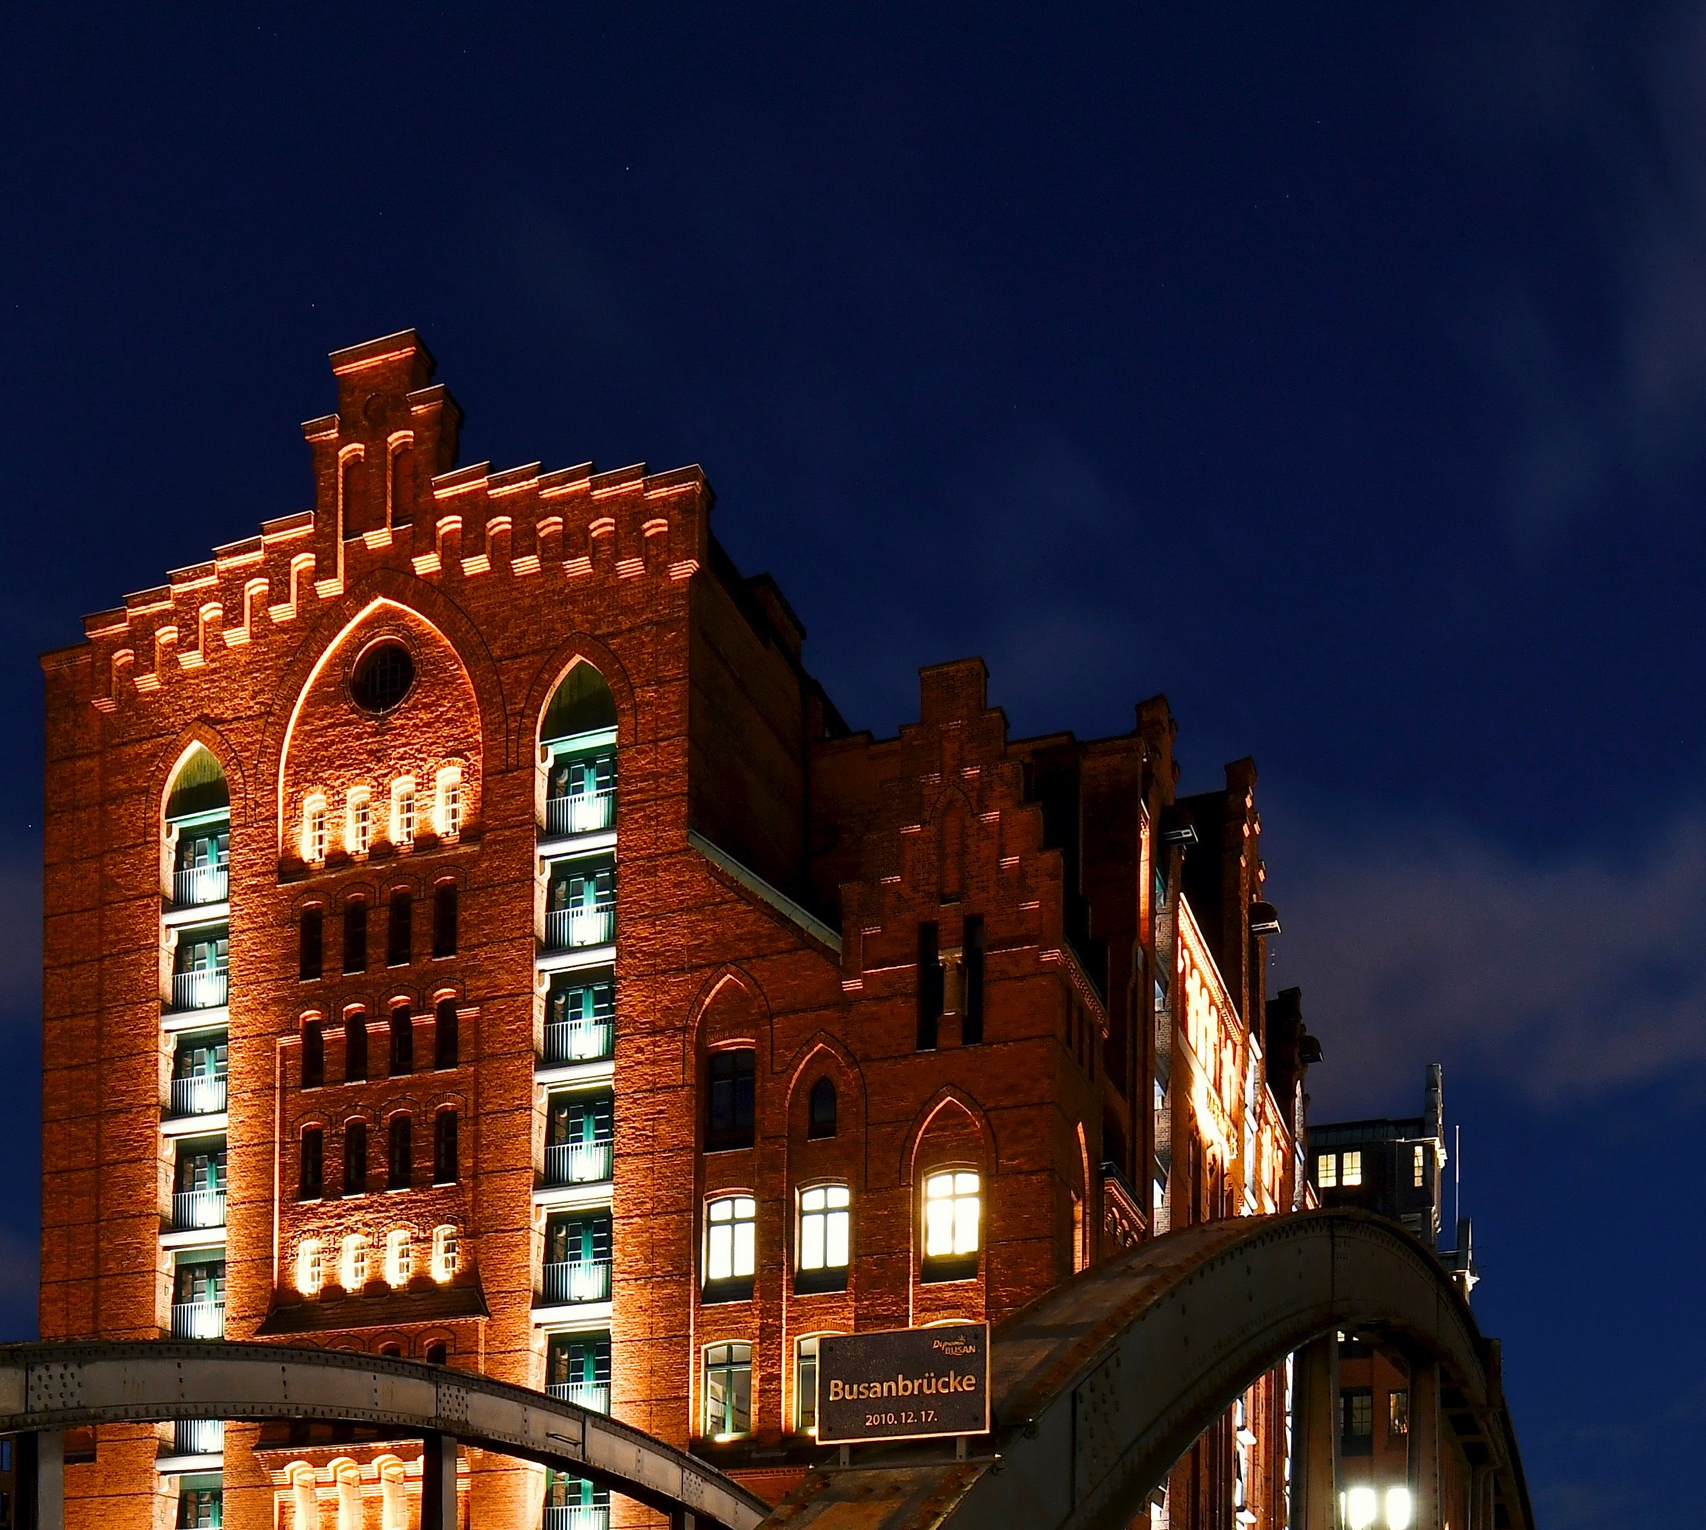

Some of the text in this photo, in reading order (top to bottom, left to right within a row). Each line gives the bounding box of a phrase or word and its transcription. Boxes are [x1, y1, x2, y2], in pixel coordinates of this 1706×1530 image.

[945, 1345, 976, 1355] BUSAN
[829, 1370, 977, 1401] Busanbrücke
[865, 1410, 938, 1426] 2010. 12. 17.
